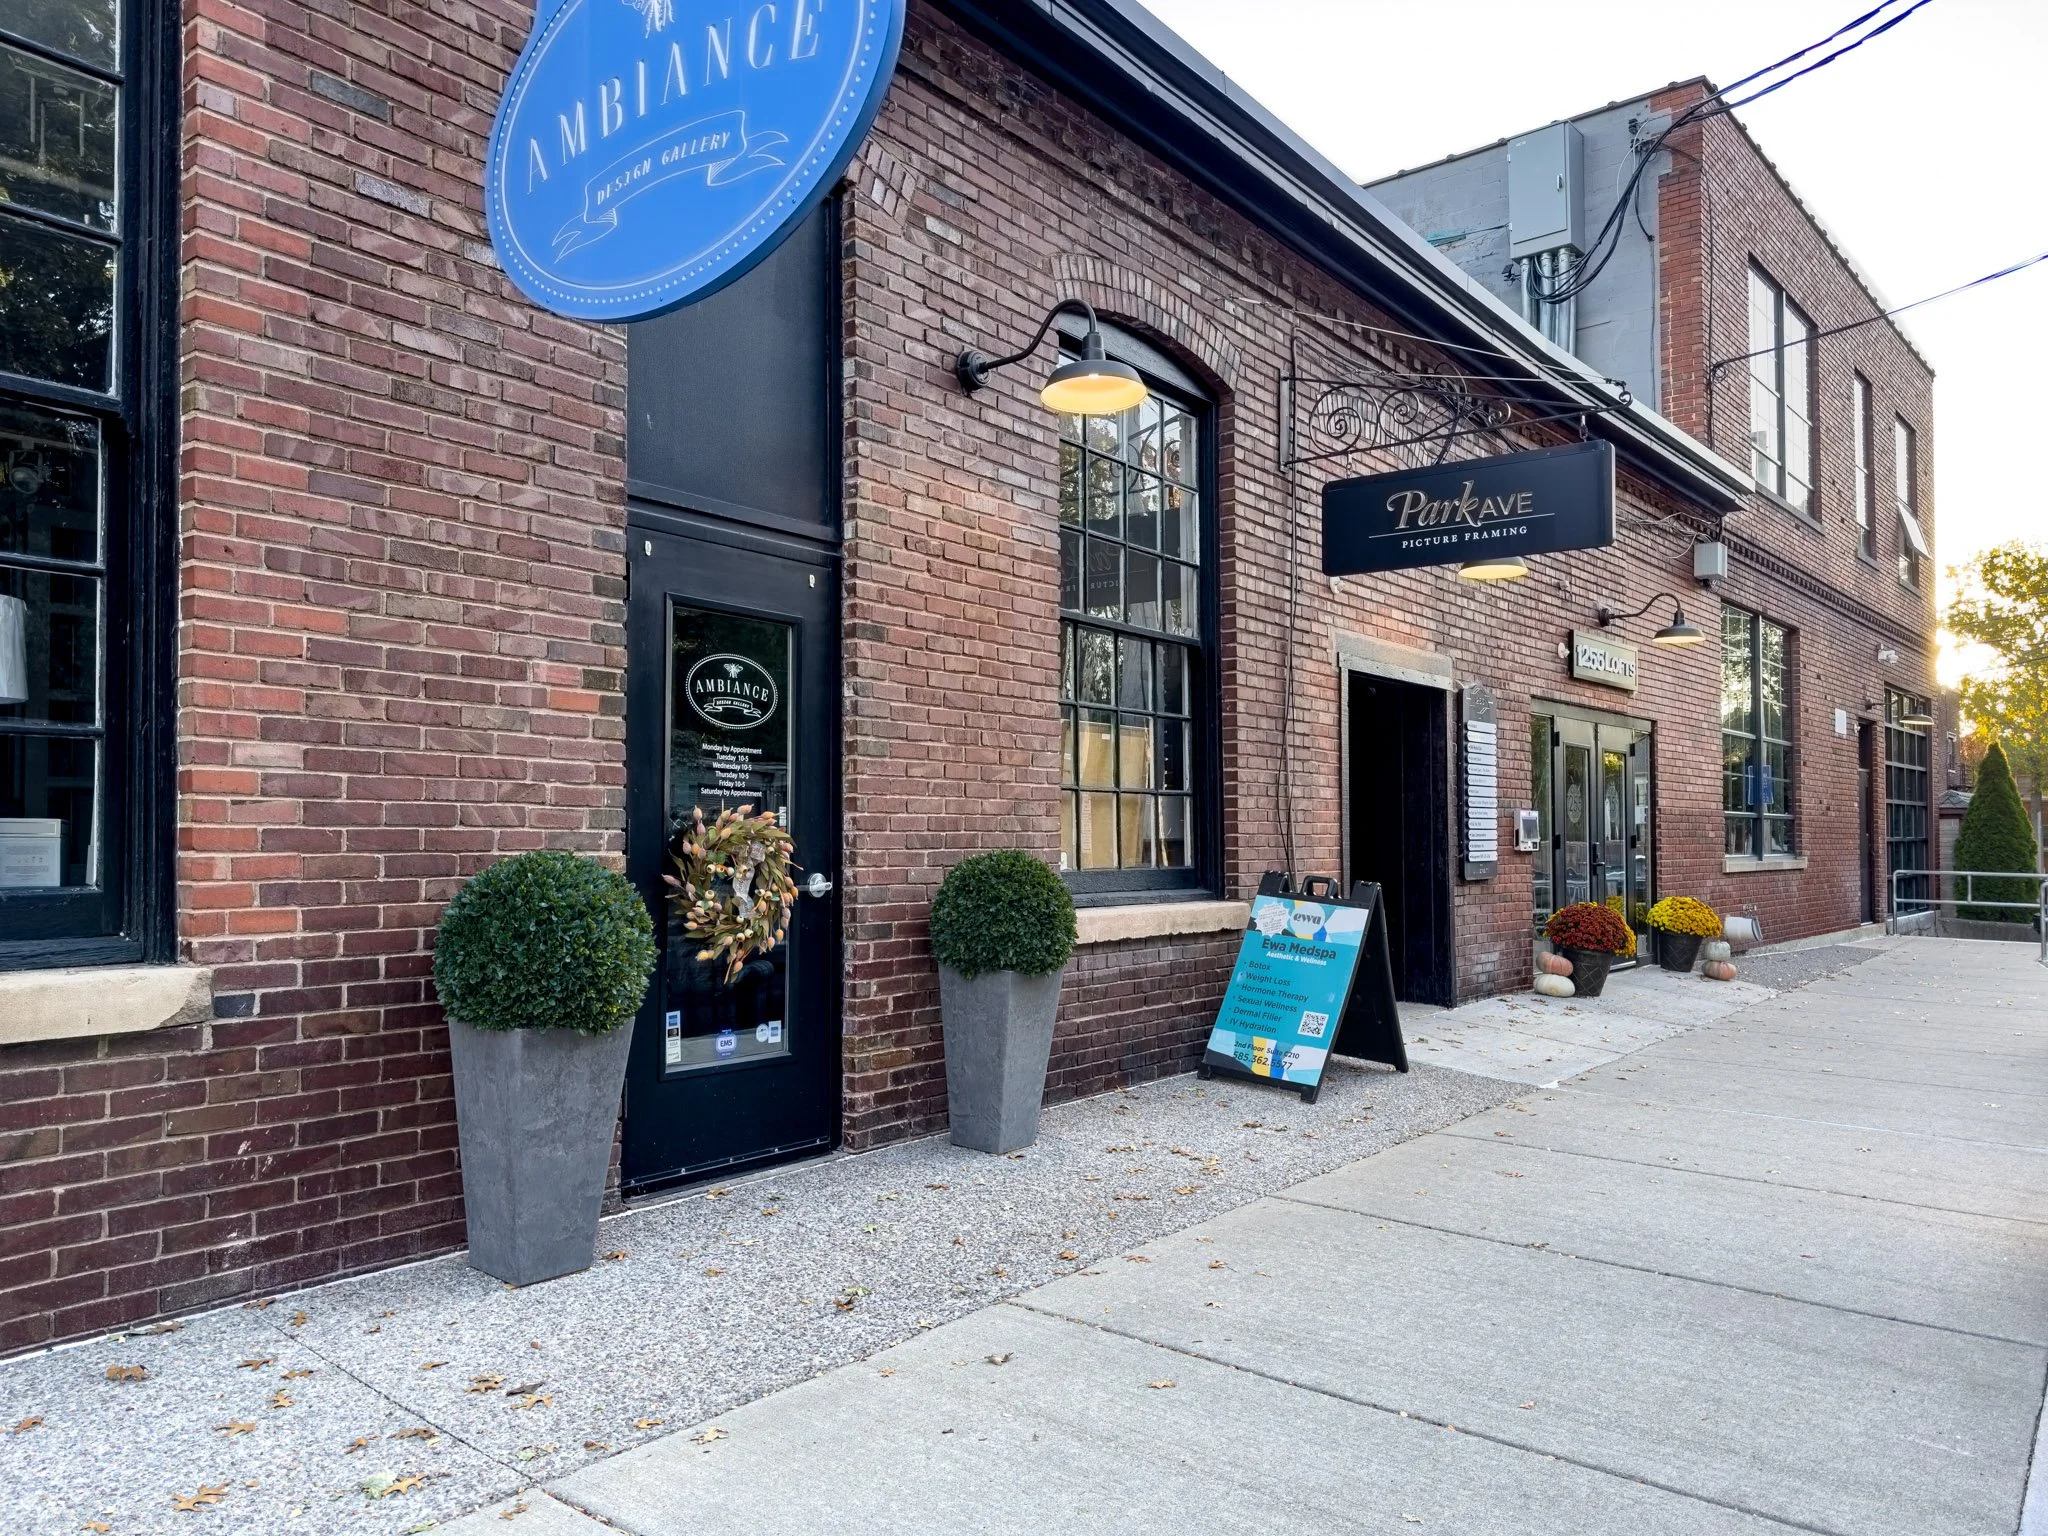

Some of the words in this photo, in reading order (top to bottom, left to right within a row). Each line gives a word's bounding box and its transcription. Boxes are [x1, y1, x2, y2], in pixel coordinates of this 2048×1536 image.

[526, 0, 823, 195] AMBIANCE
[597, 157, 652, 206] DESIGN
[661, 131, 730, 166] GALLERY
[1402, 534, 1458, 549] PICTURE
[1465, 525, 1528, 541] FRAMING
[695, 678, 769, 702] AMBIANCE
[702, 743, 723, 752] Monday
[722, 744, 730, 753] by
[730, 745, 762, 754] Appointment
[715, 752, 736, 762] Tuesday
[712, 761, 740, 771] Wednesday
[715, 770, 738, 780] Thursday
[738, 772, 750, 780] 10-5
[718, 779, 735, 788] Friday
[700, 787, 723, 796] Saturday
[723, 788, 730, 797] by
[730, 789, 762, 797] Appointment
[1293, 912, 1322, 925] ewa
[1261, 938, 1287, 953] Ewa
[1288, 941, 1338, 960] Medspa
[1248, 960, 1271, 971] Botox
[1266, 951, 1294, 961] Aesthetic
[1300, 956, 1327, 966] Wellness
[1246, 971, 1273, 984] Weight
[1273, 977, 1291, 987] Loss
[1241, 983, 1276, 996] Hormone
[1278, 989, 1309, 1004] Therapy
[1237, 995, 1263, 1006] Sexual
[1264, 1000, 1298, 1013] Wellness
[1233, 1006, 1261, 1018] Dermal
[1262, 1011, 1282, 1022] Filler
[1229, 1017, 1239, 1025] IV
[1239, 1020, 1277, 1034] Hydration
[1233, 1041, 1247, 1049] 2nd
[1247, 1043, 1265, 1052] Floor
[1266, 1047, 1283, 1056] Suite
